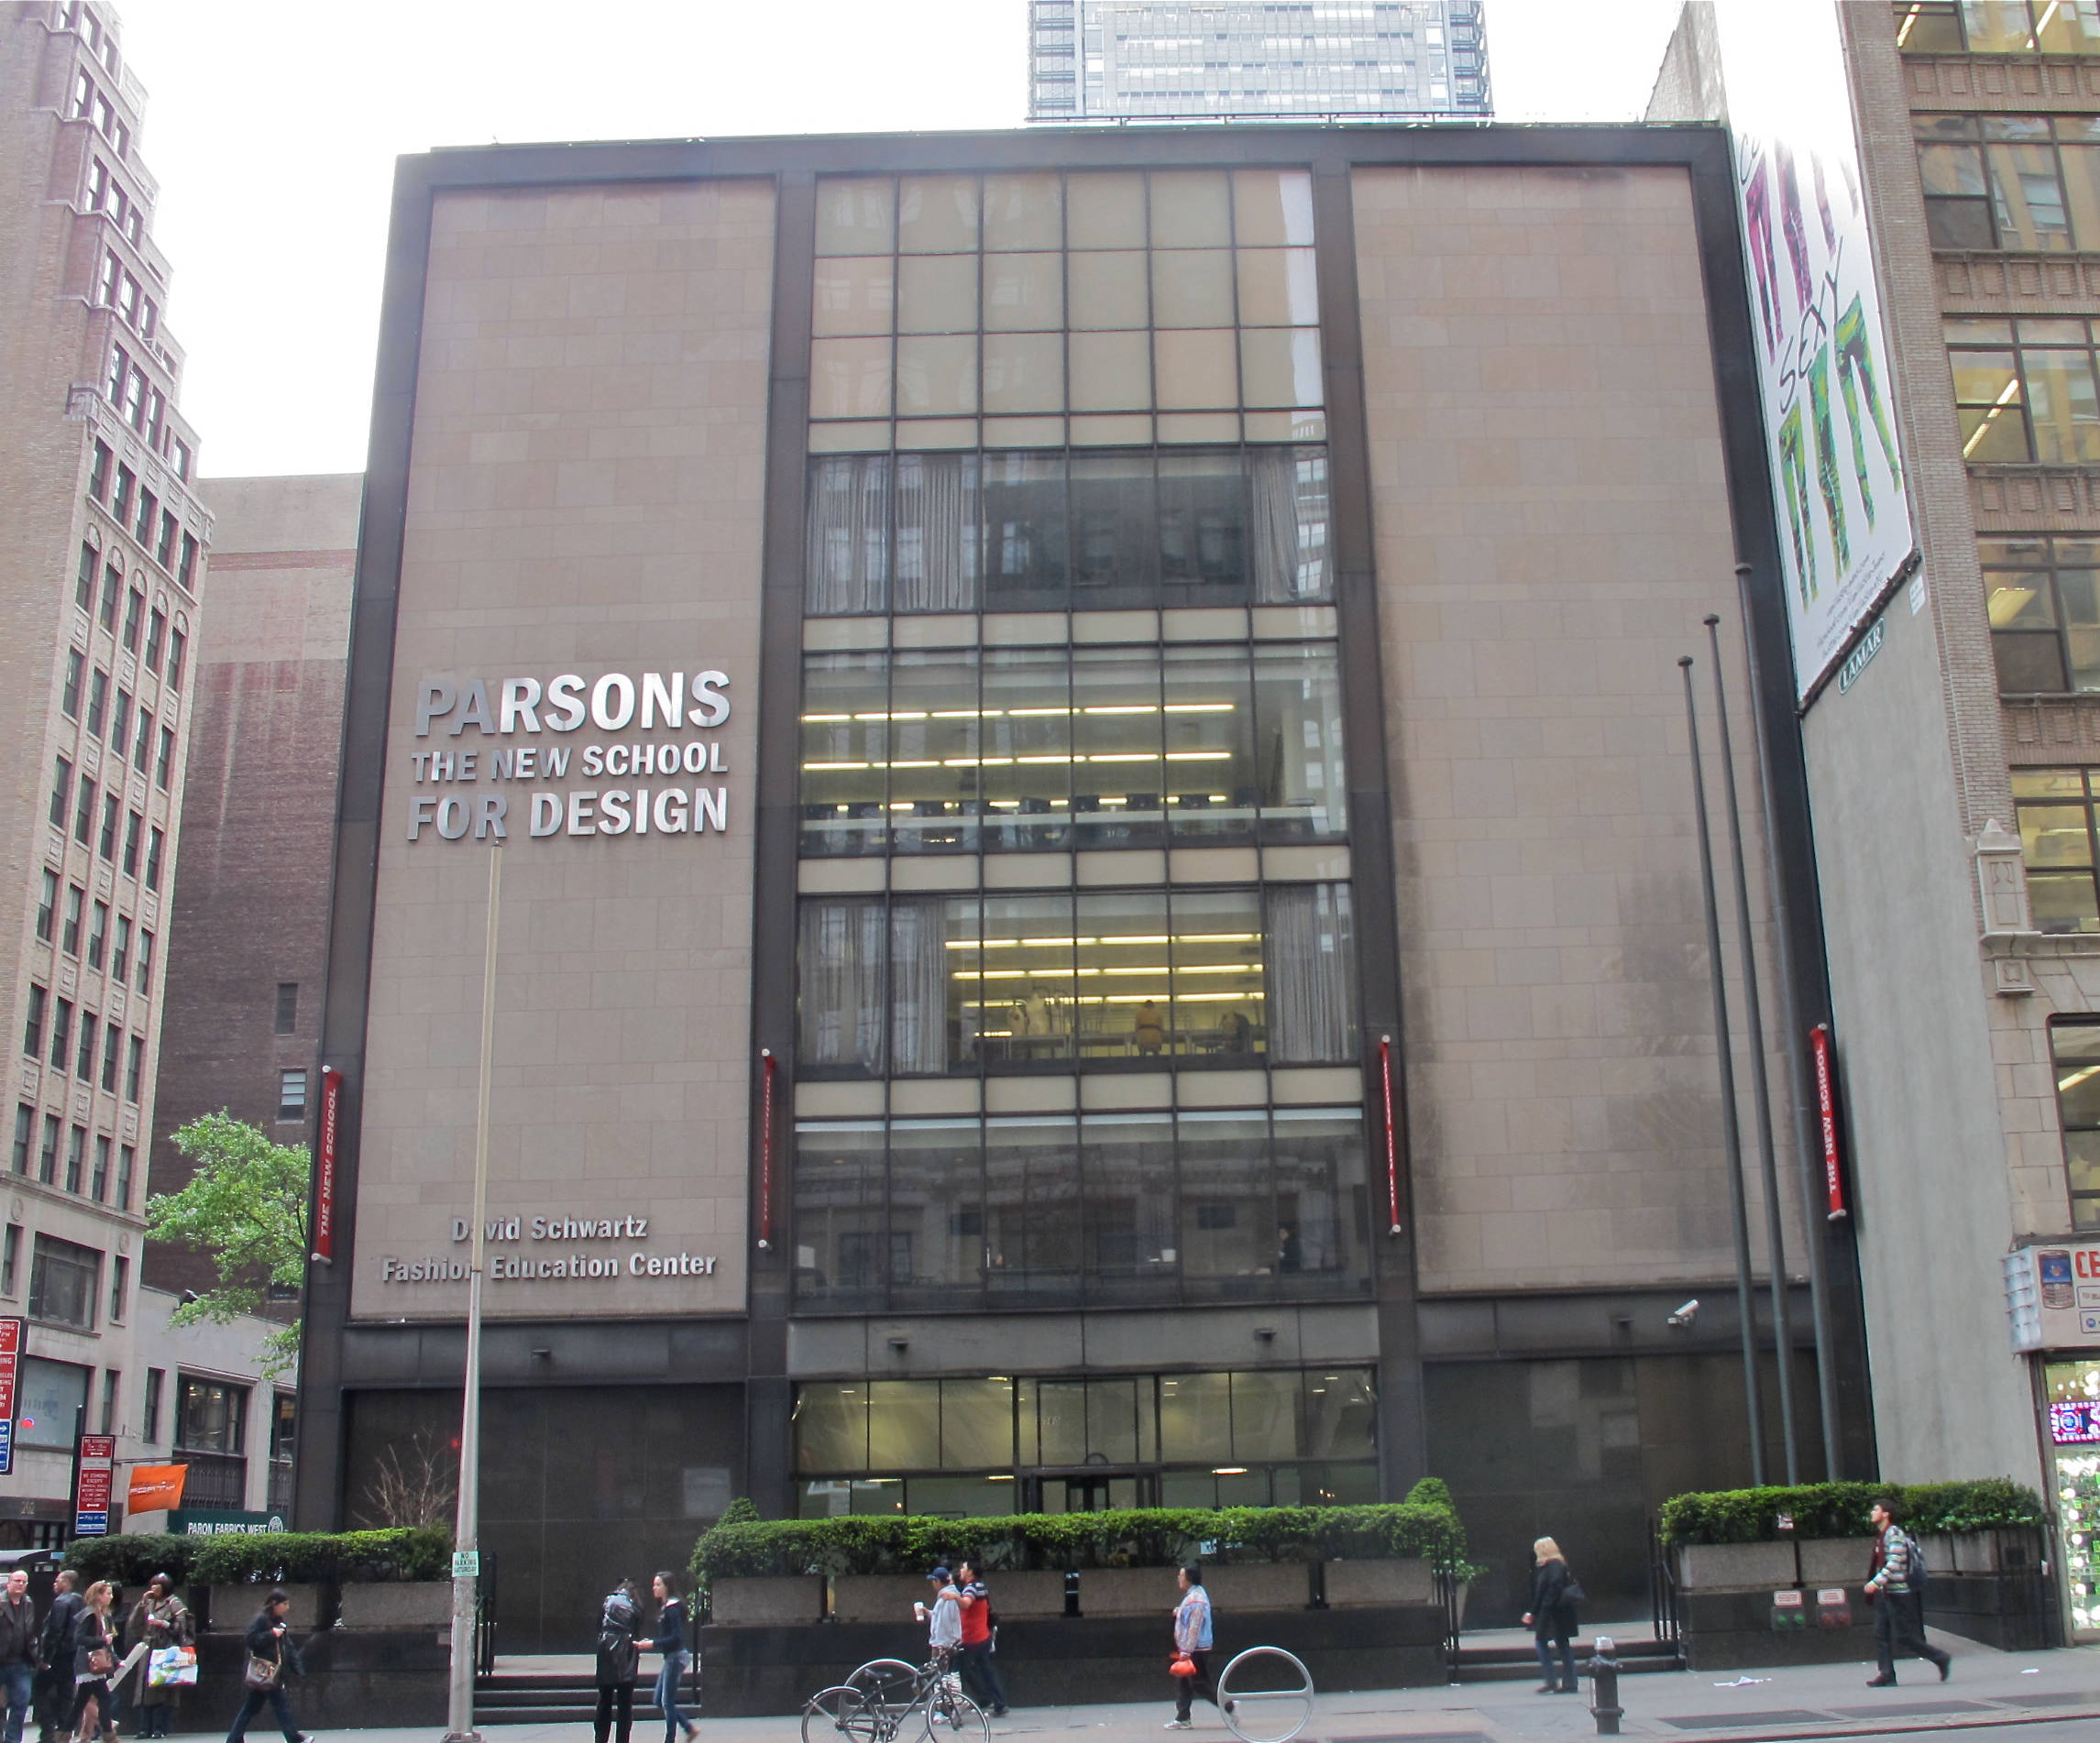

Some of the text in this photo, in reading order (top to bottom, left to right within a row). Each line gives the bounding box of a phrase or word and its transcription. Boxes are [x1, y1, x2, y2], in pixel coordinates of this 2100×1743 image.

[1779, 235, 1843, 414] SEXY
[1842, 626, 1883, 687] LAMAR
[414, 670, 731, 736] PARSONS
[411, 741, 729, 782] THE NEW SCHOOL
[406, 787, 727, 840] FOR DESIGN
[1816, 1044, 1837, 1194] THE NEW SCHOOL
[321, 1089, 336, 1236] THE NEW SCHOOL
[452, 1214, 648, 1242] Dvid Schwartz
[490, 1254, 619, 1279] Education
[629, 1252, 718, 1277] Center
[188, 1522, 268, 1535] PARON FABRICS WEST
